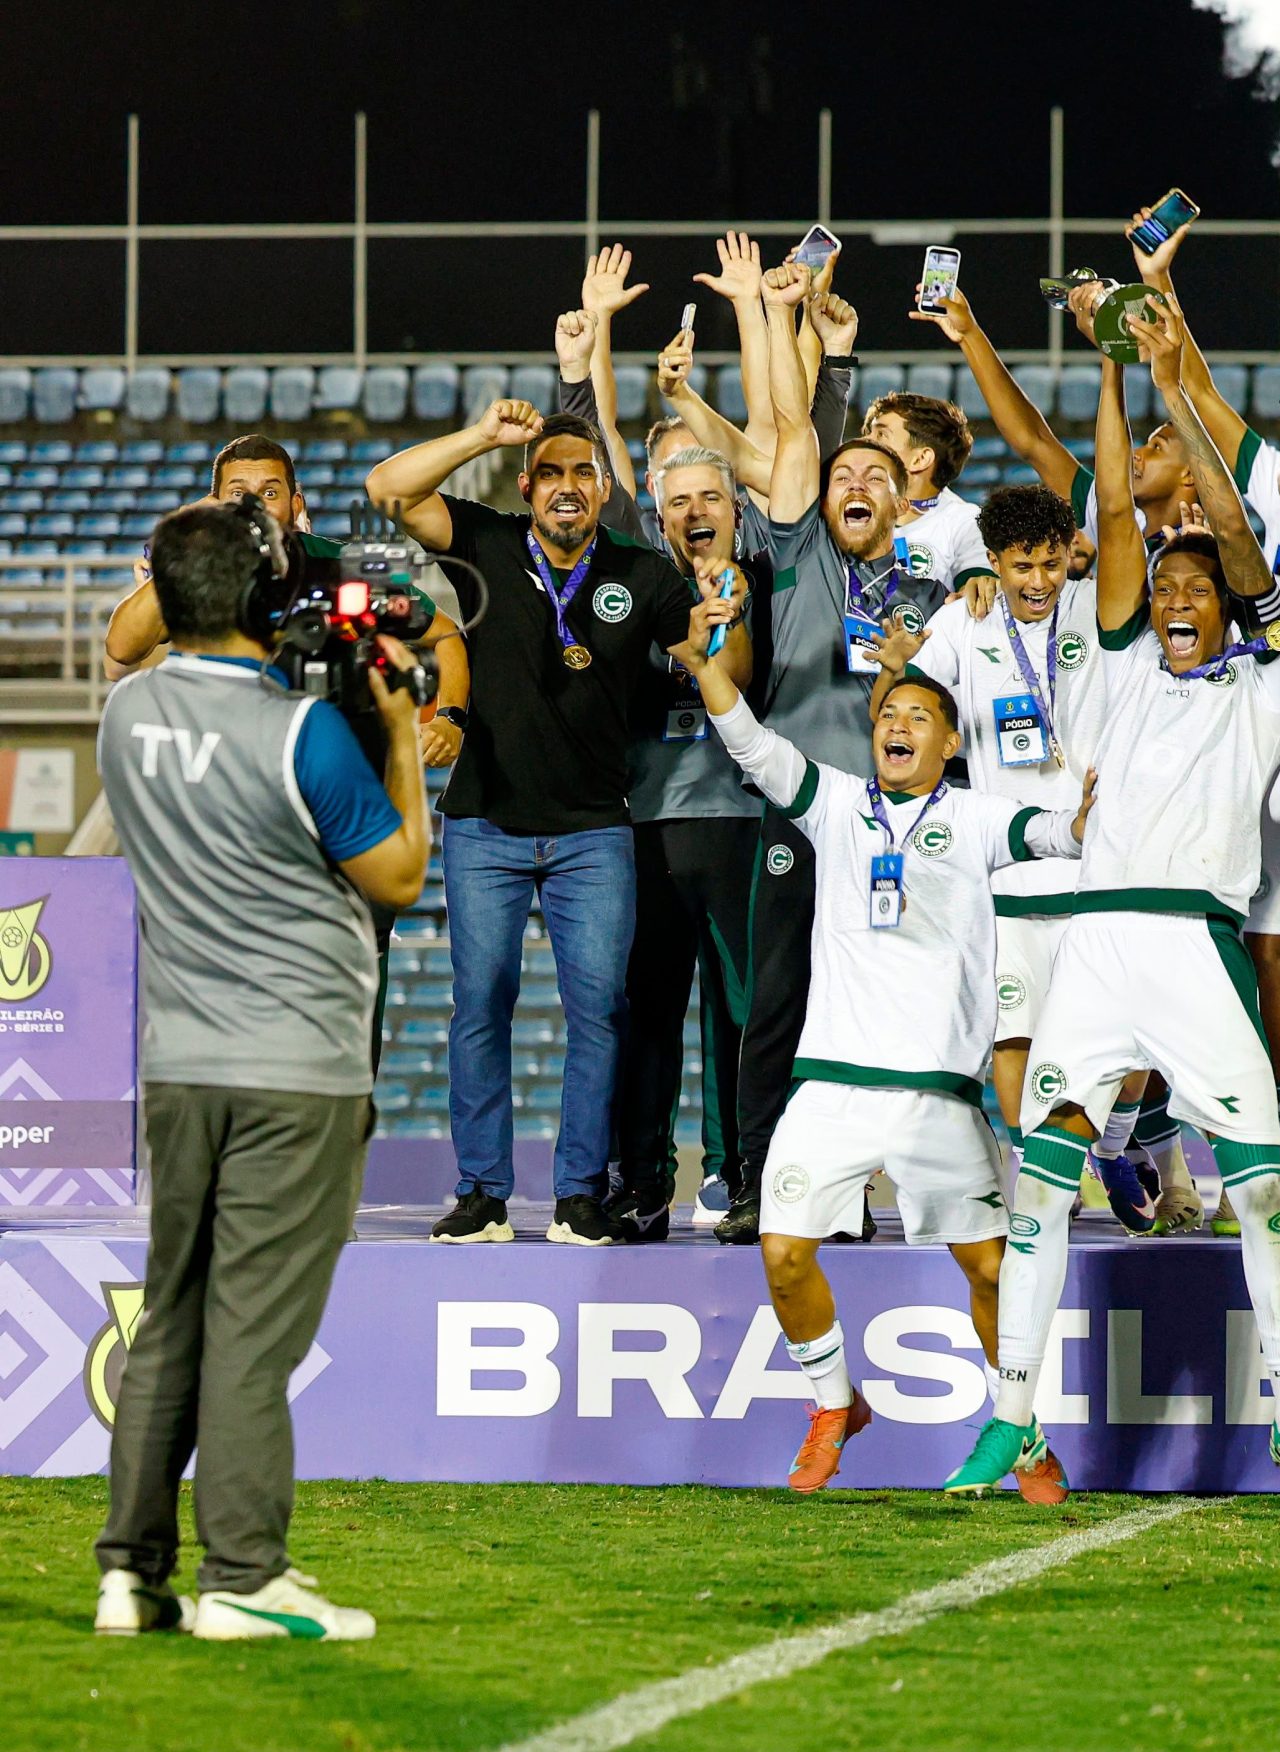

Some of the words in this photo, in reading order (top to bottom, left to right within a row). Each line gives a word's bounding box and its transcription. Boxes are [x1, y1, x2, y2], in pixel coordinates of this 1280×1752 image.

[599, 590, 625, 615] G
[856, 637, 879, 651] PÓDIO
[1058, 639, 1082, 664] G
[1005, 716, 1033, 730] PÓDIO
[131, 722, 221, 784] TV
[919, 827, 946, 851] G
[14, 1022, 53, 1033] SÉRIE
[55, 1023, 64, 1032] B
[1036, 1070, 1061, 1098] G
